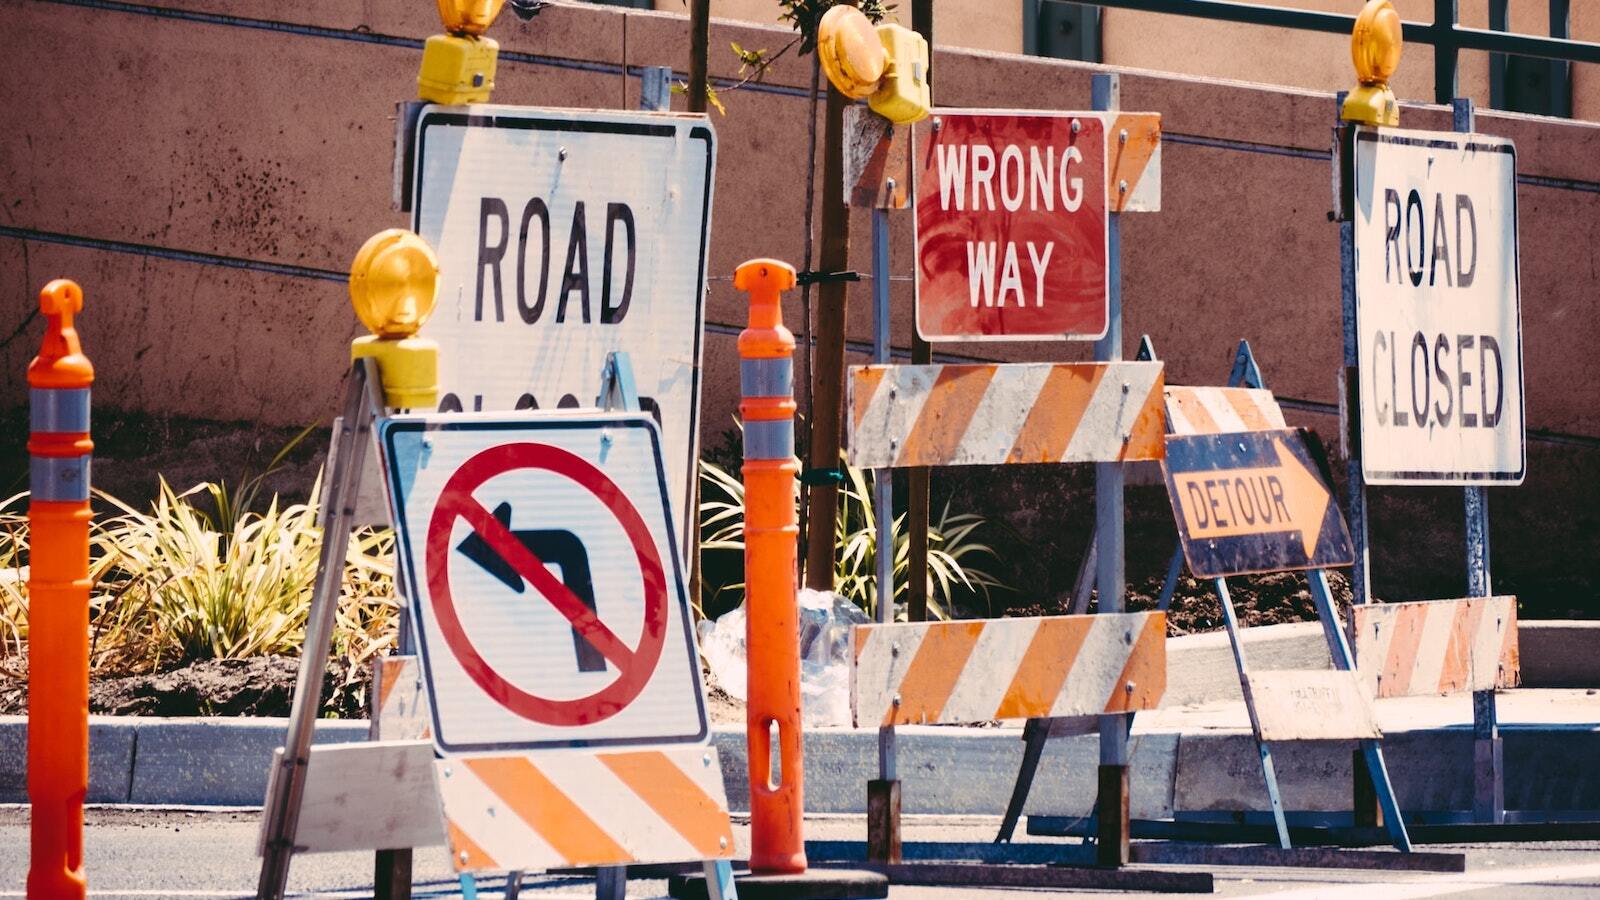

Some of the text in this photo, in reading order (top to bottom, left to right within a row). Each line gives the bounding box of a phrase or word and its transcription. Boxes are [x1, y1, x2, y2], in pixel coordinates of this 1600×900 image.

[937, 144, 1084, 213] WRONG
[474, 196, 637, 325] ROAD
[966, 241, 1055, 308] WAY
[1385, 188, 1478, 289] ROAD
[1372, 330, 1504, 428] CLOSED
[1186, 475, 1292, 529] DETOUR
